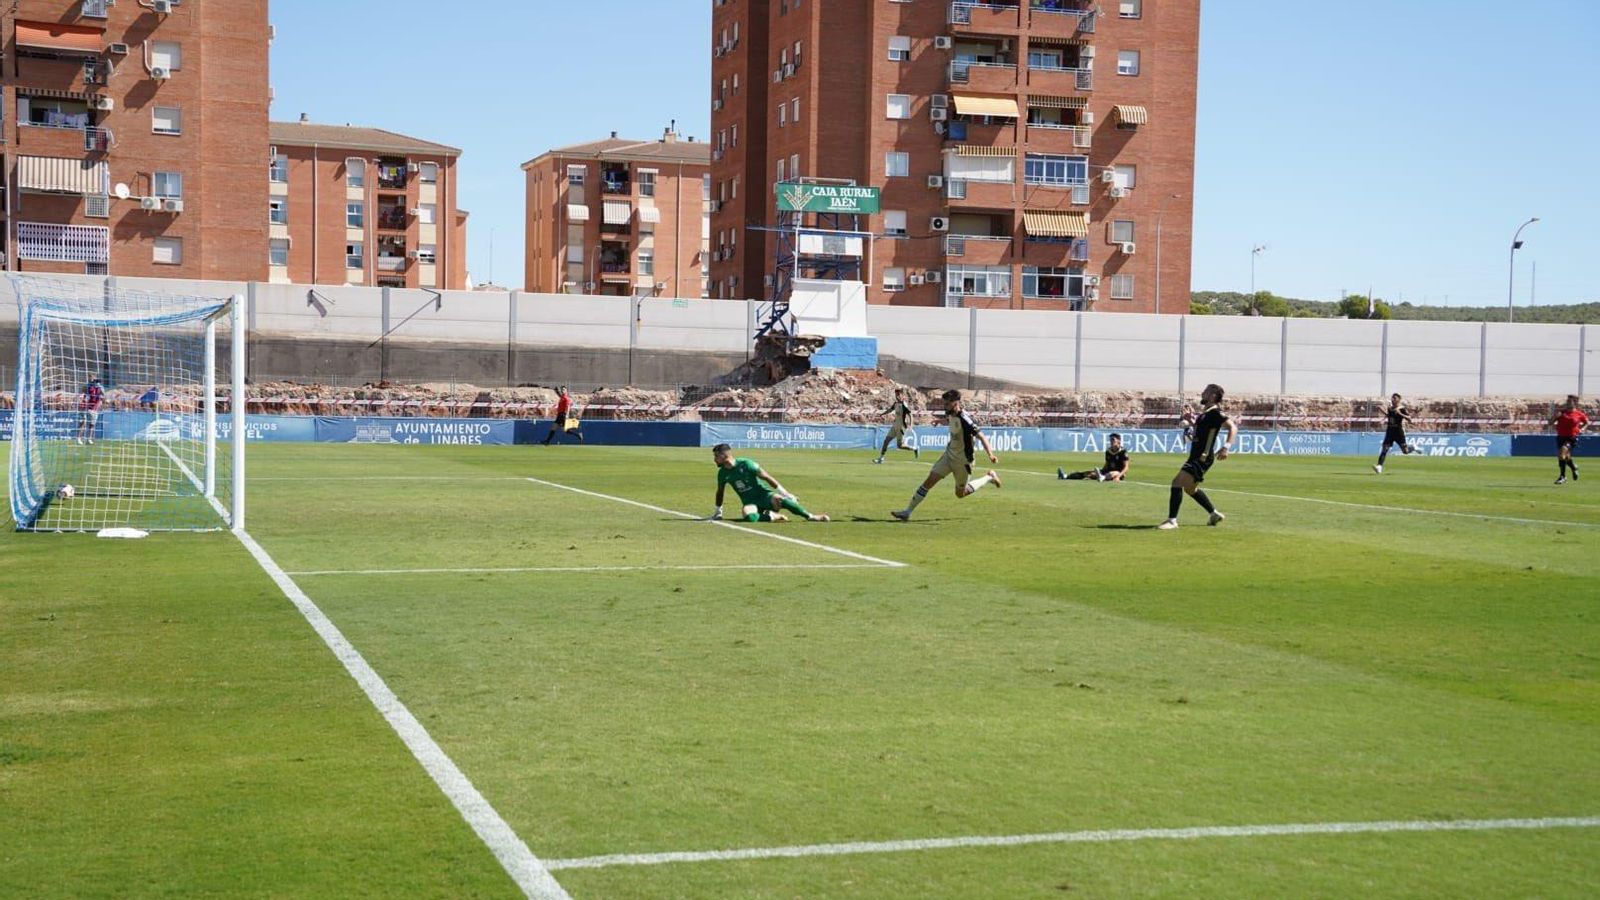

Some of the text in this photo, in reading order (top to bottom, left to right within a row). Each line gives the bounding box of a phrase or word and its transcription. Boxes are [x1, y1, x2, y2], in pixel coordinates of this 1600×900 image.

[840, 187, 875, 198] RURAL
[395, 422, 491, 435] AYUNTAMIENTO
[746, 426, 758, 440] de
[785, 430, 792, 443] y
[403, 434, 482, 445] de LINARES
